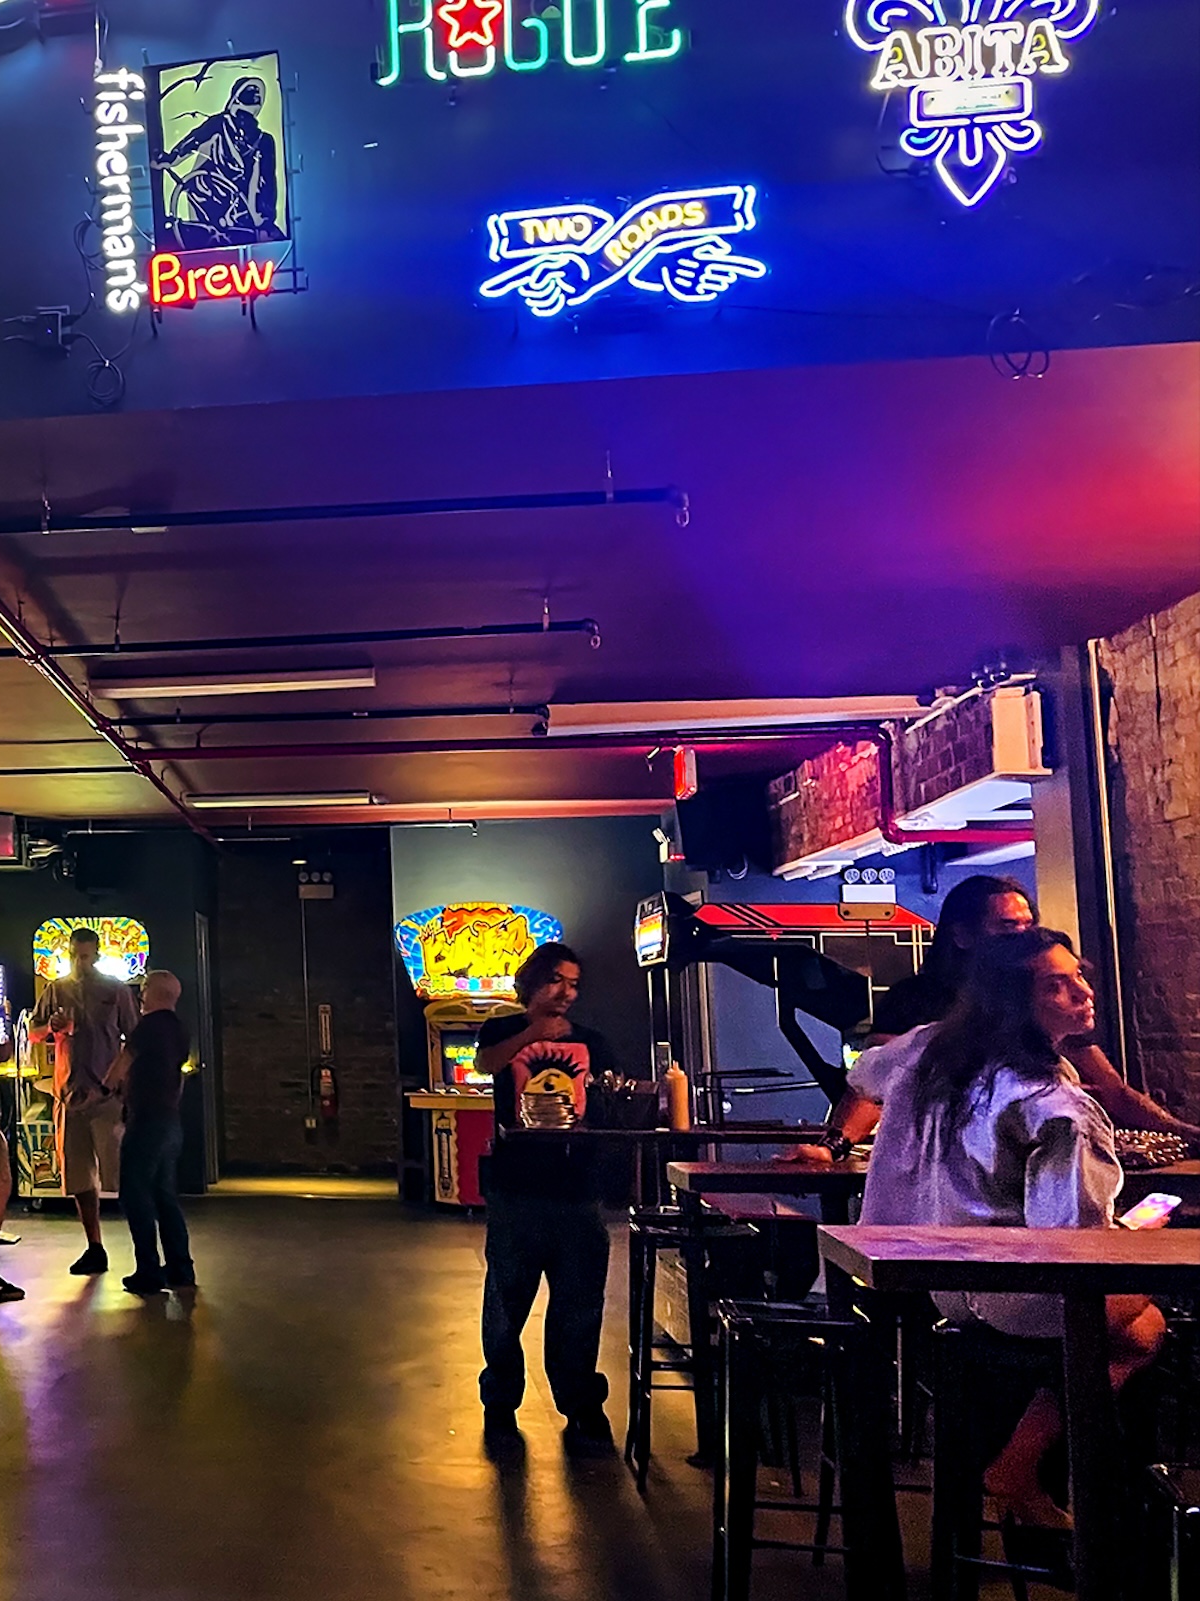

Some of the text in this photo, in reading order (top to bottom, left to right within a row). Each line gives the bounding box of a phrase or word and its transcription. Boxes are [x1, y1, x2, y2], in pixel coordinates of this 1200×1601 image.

[871, 18, 1069, 89] ABITA
[94, 67, 148, 314] fisherman's
[519, 201, 706, 267] TWO ROADS
[151, 253, 274, 304] Brew
